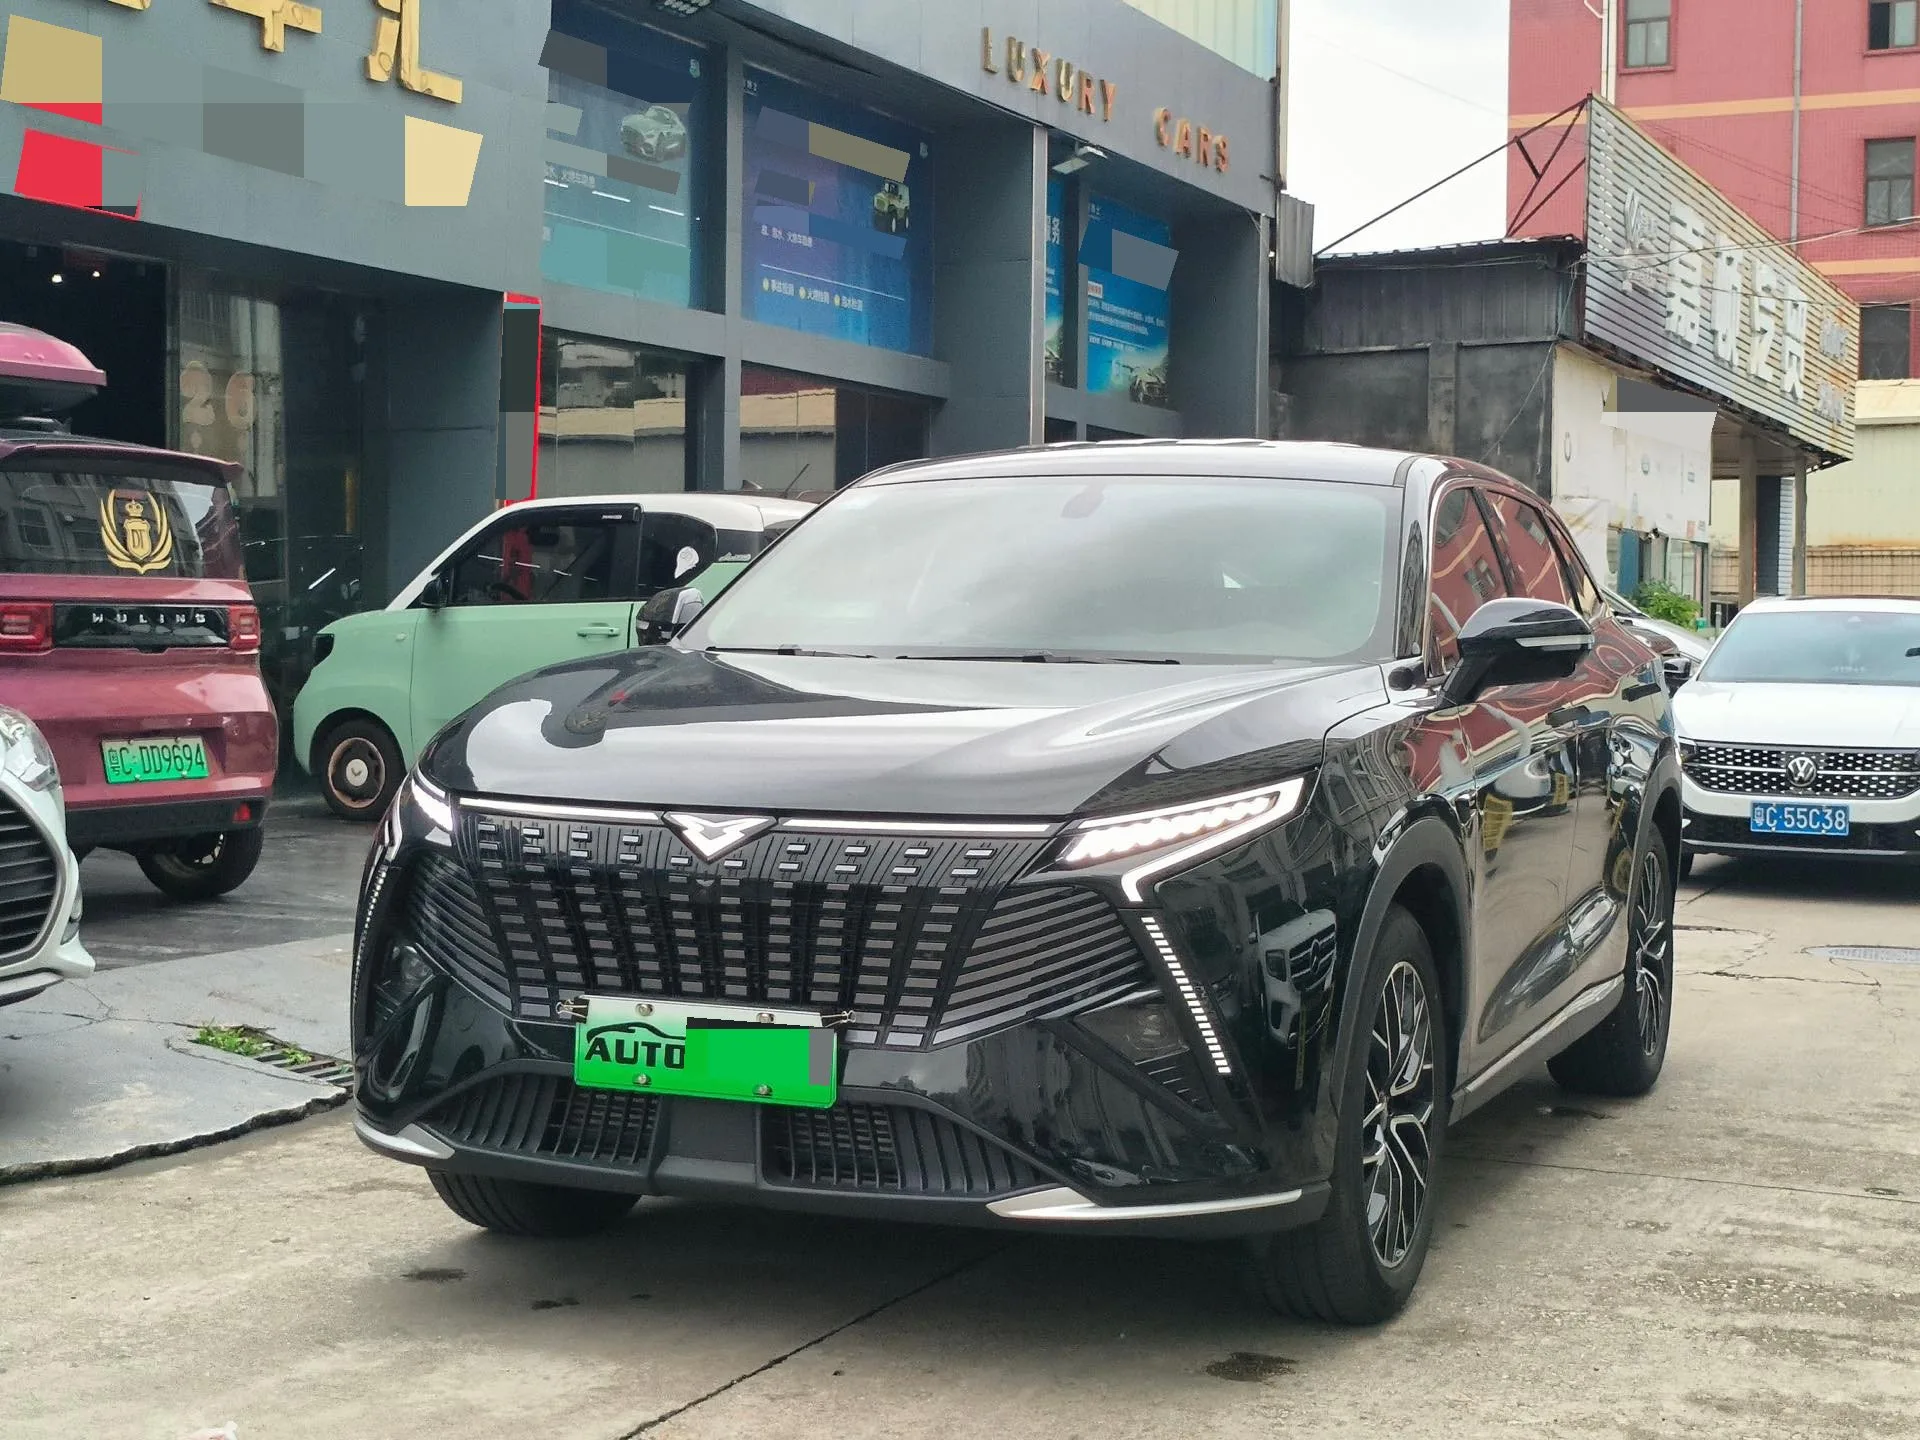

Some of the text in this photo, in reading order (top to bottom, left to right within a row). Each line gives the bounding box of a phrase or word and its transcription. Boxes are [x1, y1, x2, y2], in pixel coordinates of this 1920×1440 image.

[982, 27, 1229, 173] LUXURY CARS
[92, 612, 206, 624] WULING
